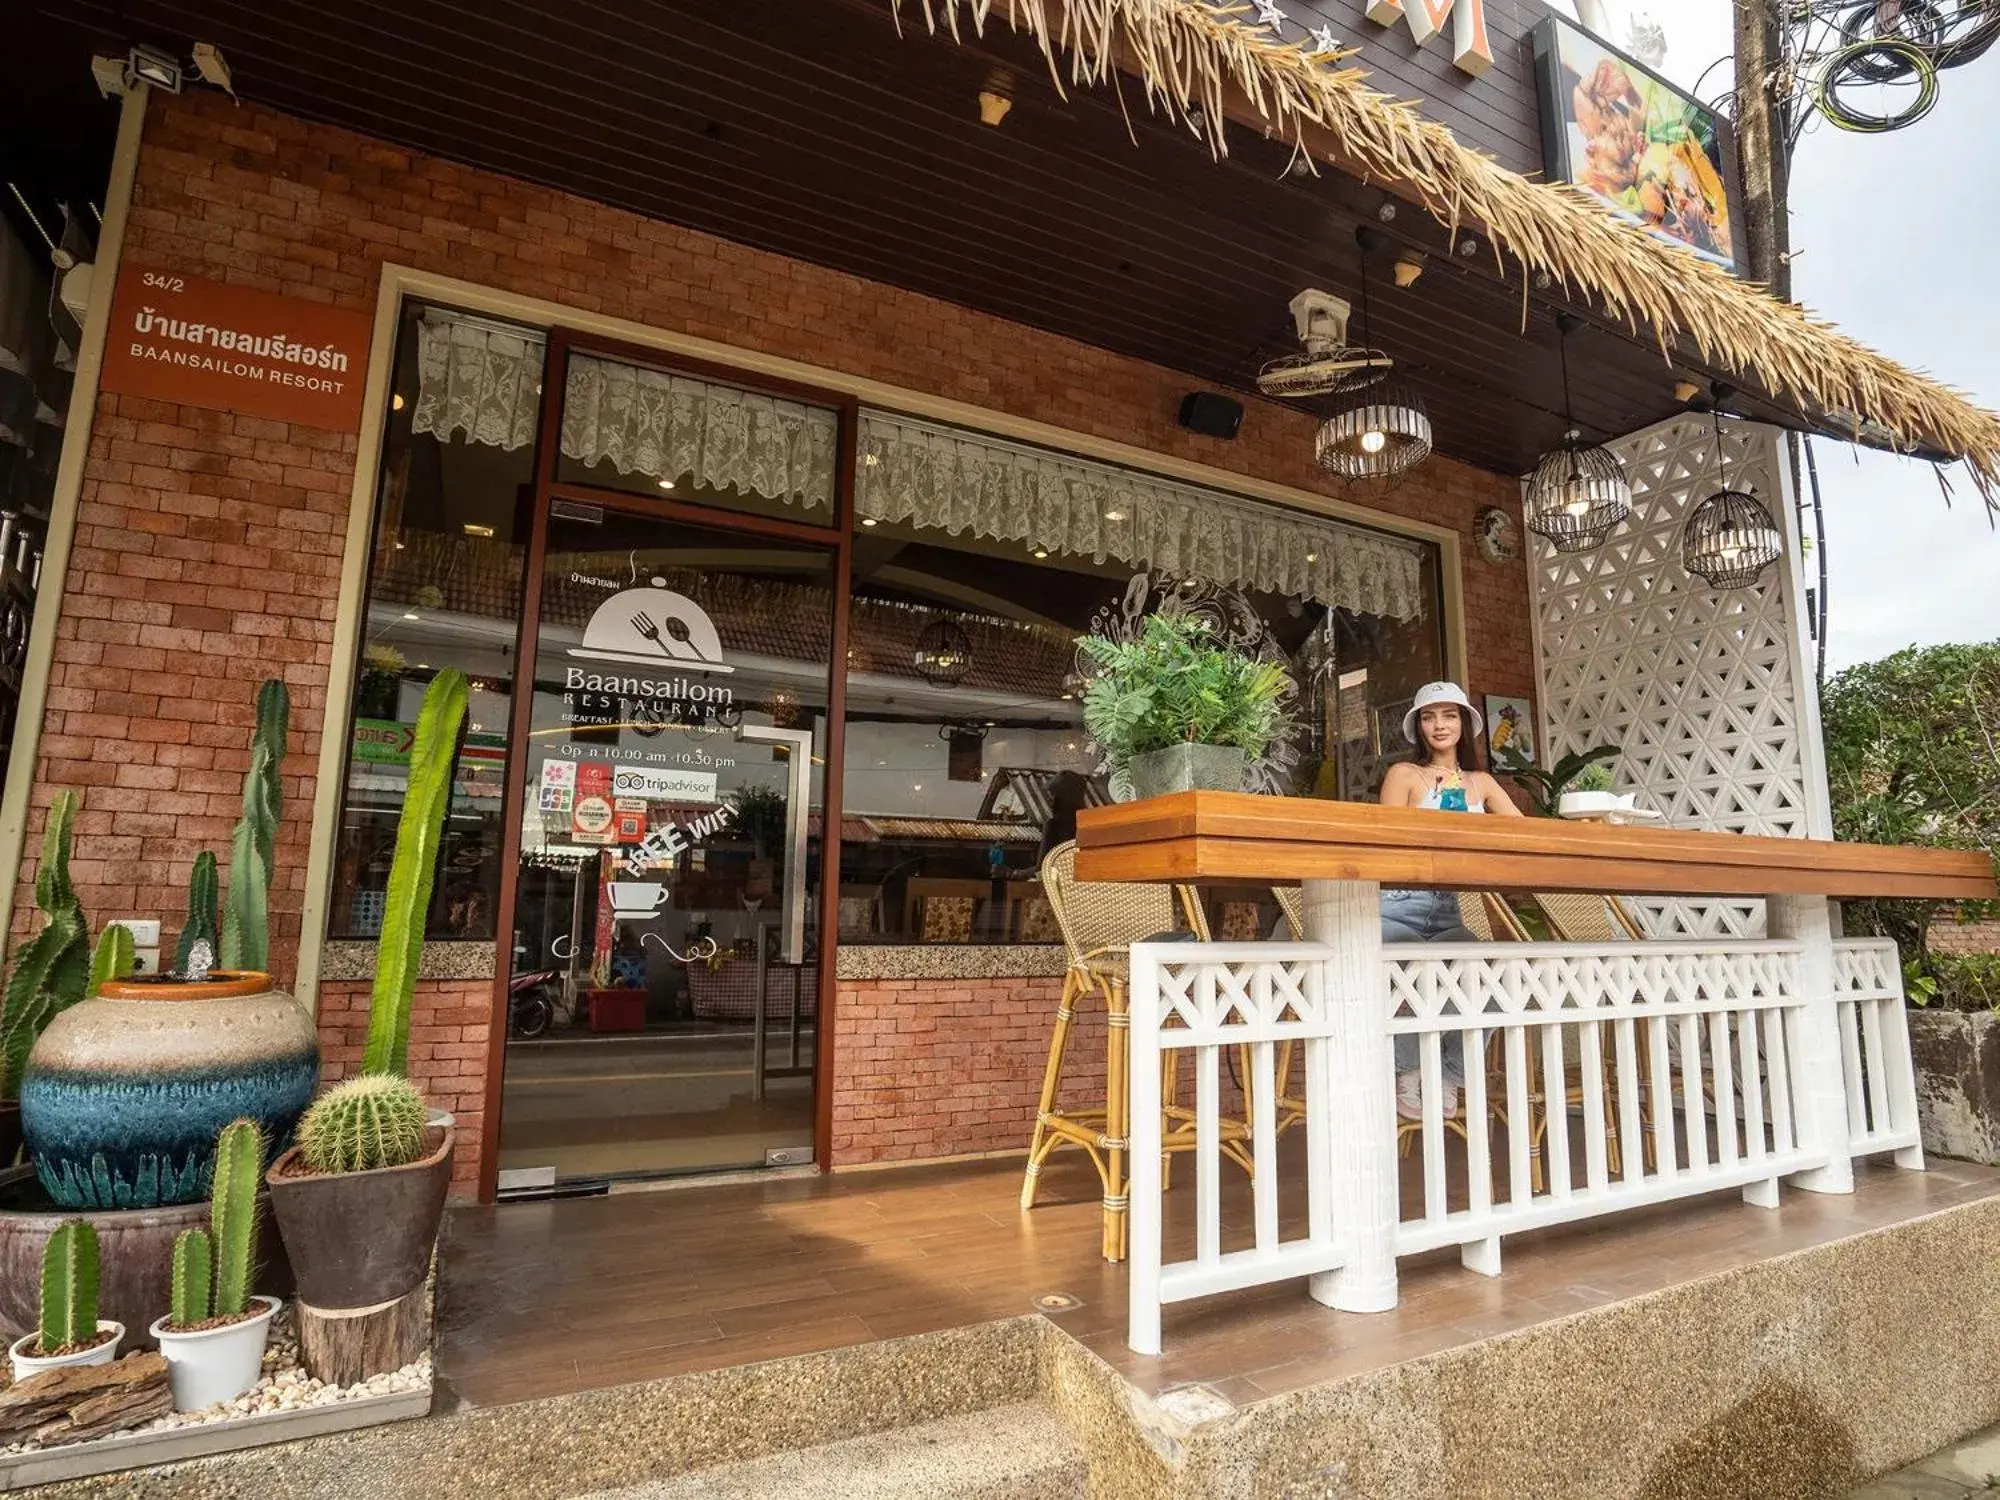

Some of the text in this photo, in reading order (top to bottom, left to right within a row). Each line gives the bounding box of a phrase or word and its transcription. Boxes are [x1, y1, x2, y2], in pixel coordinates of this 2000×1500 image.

[143, 272, 184, 293] 34/2
[135, 306, 348, 373] บ้านสายลมรีสอร์ท
[130, 343, 344, 394] BAANSAILOM RESORT
[565, 667, 733, 704] Baansailom
[563, 692, 734, 719] RESTAURANT
[561, 744, 598, 758] Opn
[646, 752, 666, 763] am
[715, 757, 736, 769] pm
[646, 777, 712, 793] tripadvisor
[626, 803, 739, 878] FREE WIFI
